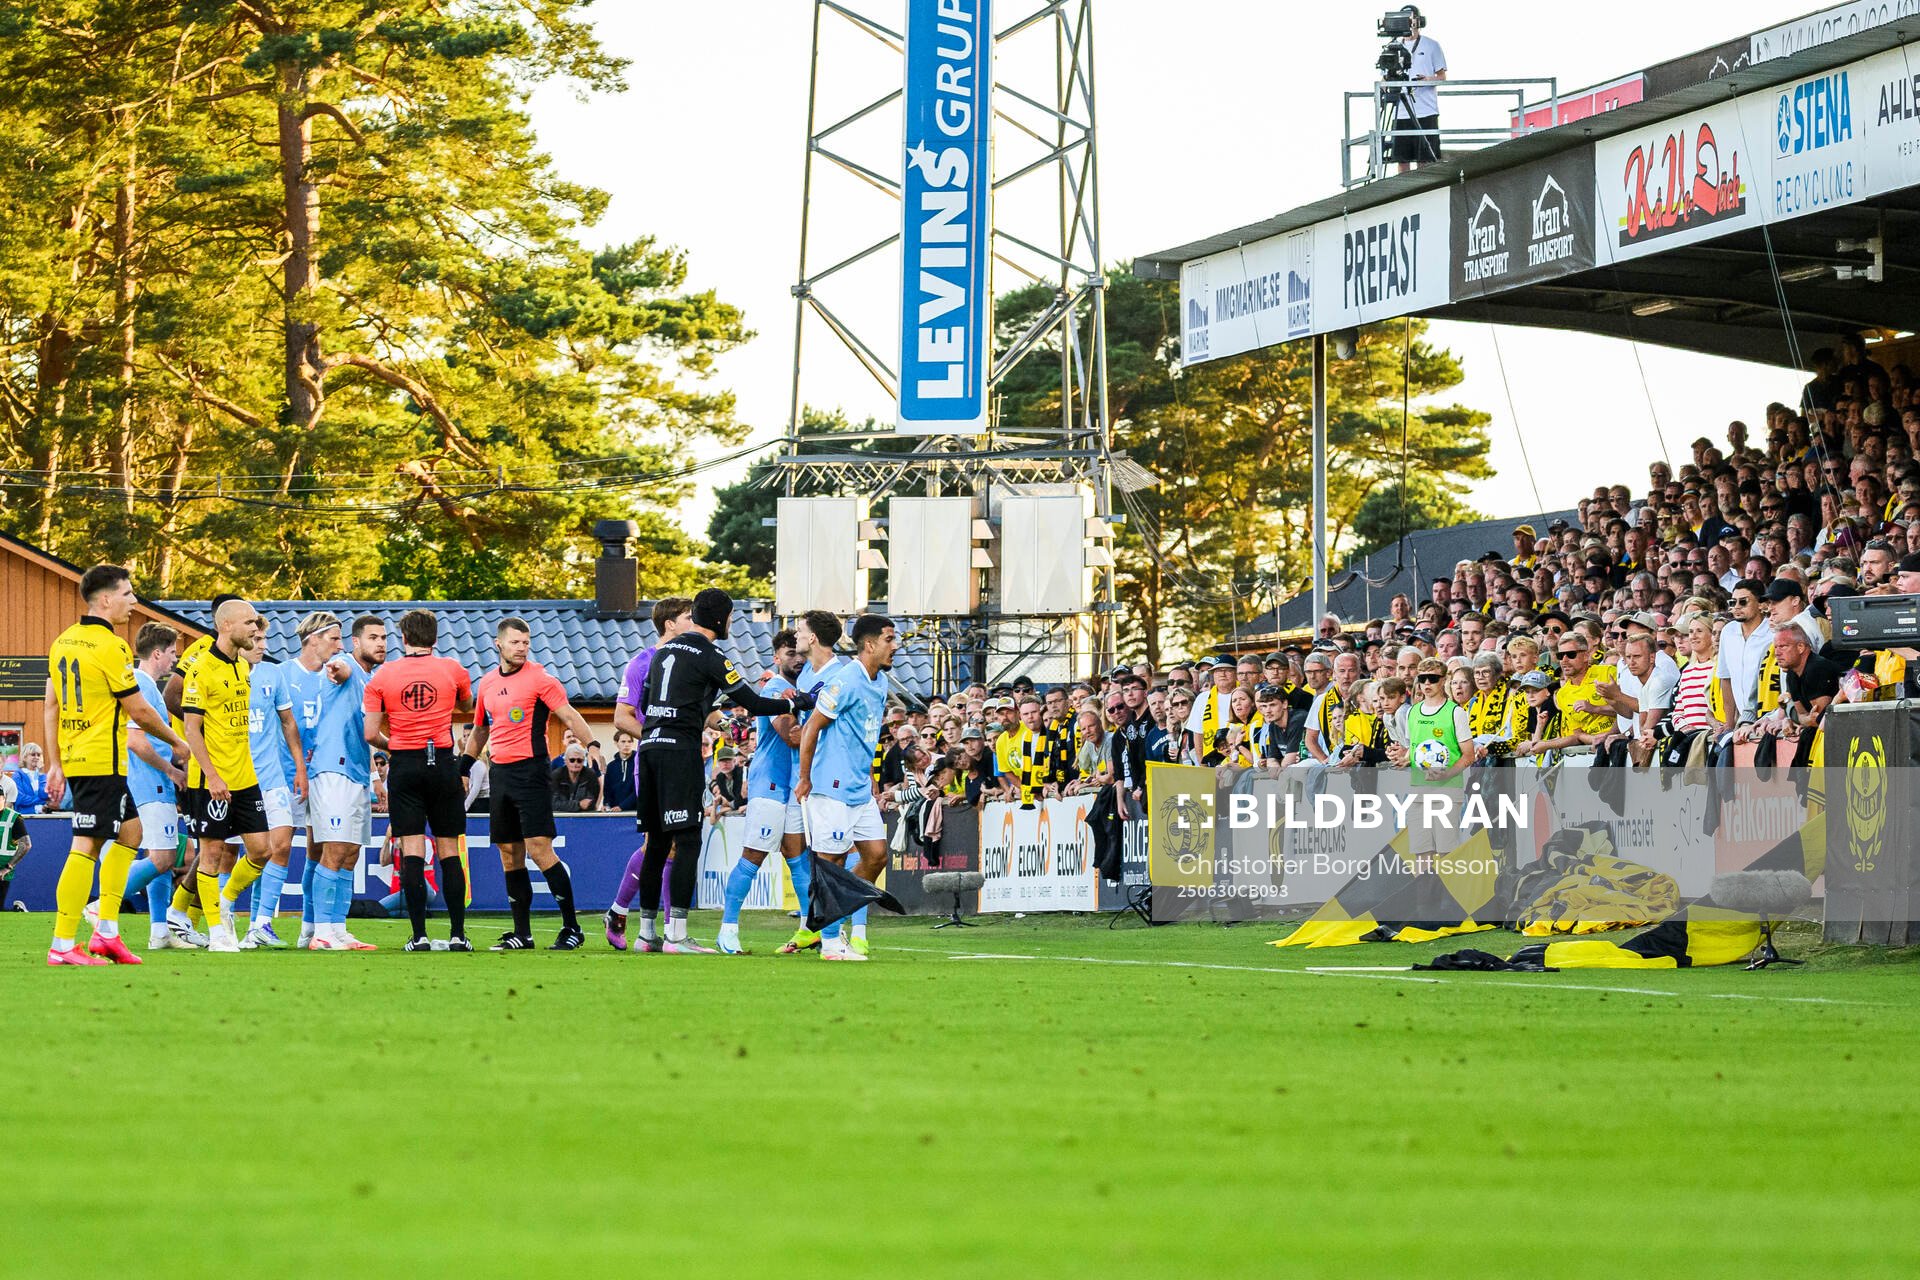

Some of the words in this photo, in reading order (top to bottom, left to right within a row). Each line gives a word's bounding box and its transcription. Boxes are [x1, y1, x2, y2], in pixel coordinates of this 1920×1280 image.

[1794, 71, 1852, 154] STENA
[1776, 161, 1852, 215] RECYCLING
[1344, 213, 1420, 309] PREFAST
[1463, 251, 1509, 282] TRANSPORT
[1527, 233, 1574, 267] TRANSPORT
[917, 146, 970, 399] LEVINS
[1288, 302, 1310, 329] MARINE
[1188, 329, 1209, 354] MARINE
[57, 656, 83, 713] 11
[659, 654, 676, 702] 1
[404, 683, 436, 710] MG
[201, 820, 209, 833] 7
[984, 846, 1009, 880] ELCOM
[1018, 844, 1046, 878] ELCOM
[1057, 842, 1083, 876] ELCOM
